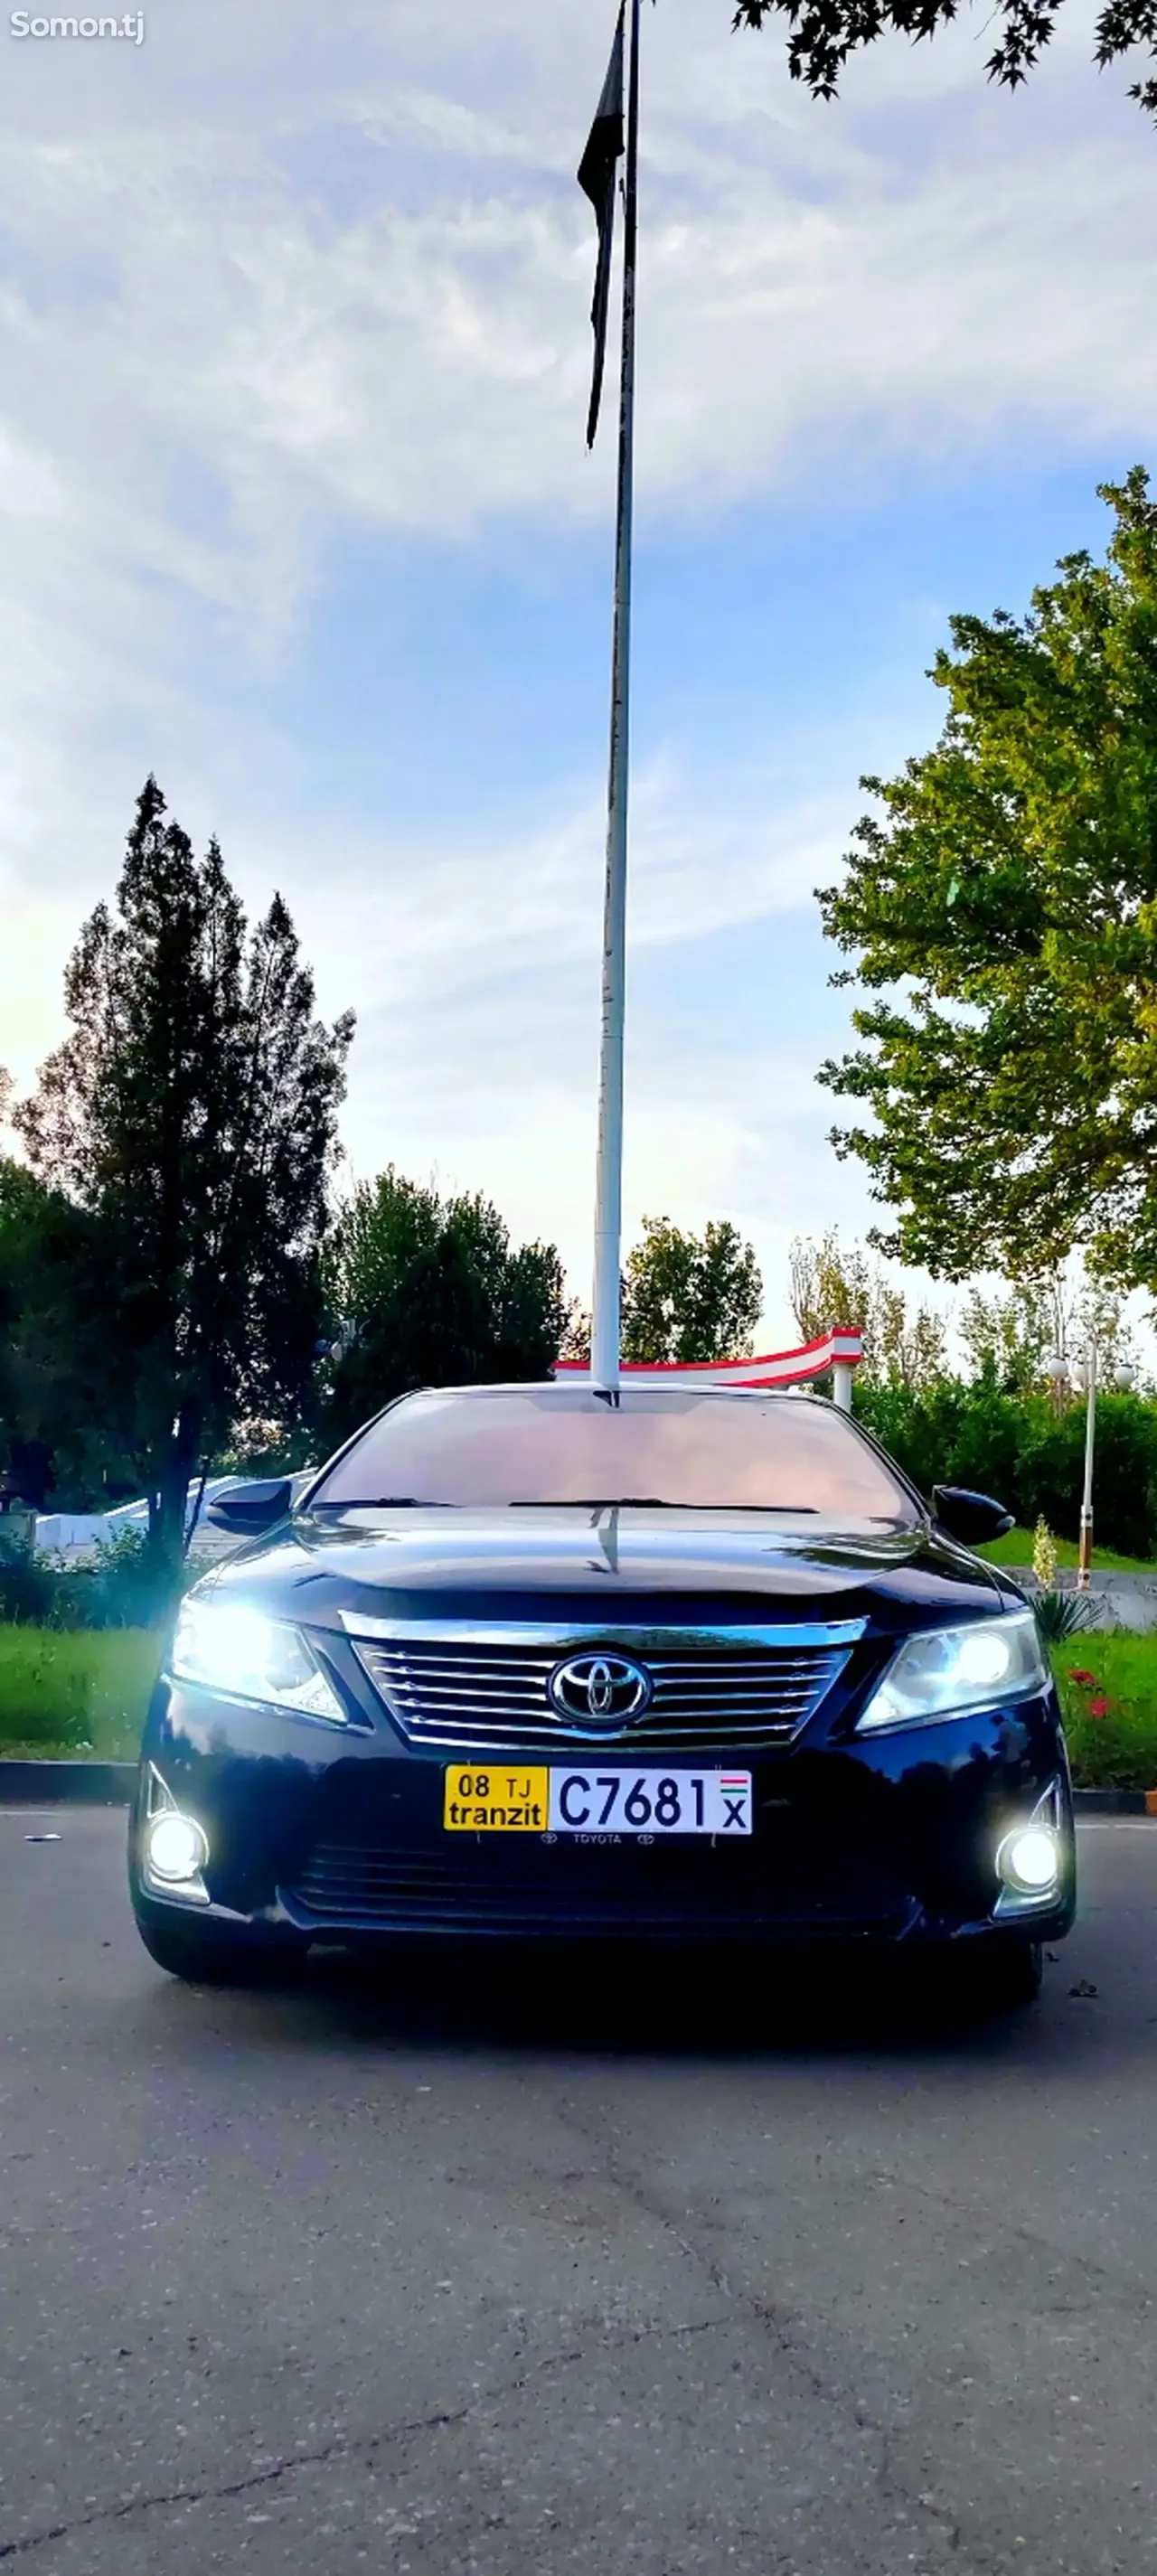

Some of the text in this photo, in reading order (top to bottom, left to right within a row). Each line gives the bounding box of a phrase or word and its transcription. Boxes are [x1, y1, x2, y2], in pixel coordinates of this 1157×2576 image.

[458, 1774, 531, 1799] 08 TJ
[559, 1775, 704, 1828] C7681
[723, 1799, 747, 1829] X
[449, 1803, 541, 1826] tranzit
[573, 1833, 622, 1845] TOYOTA
